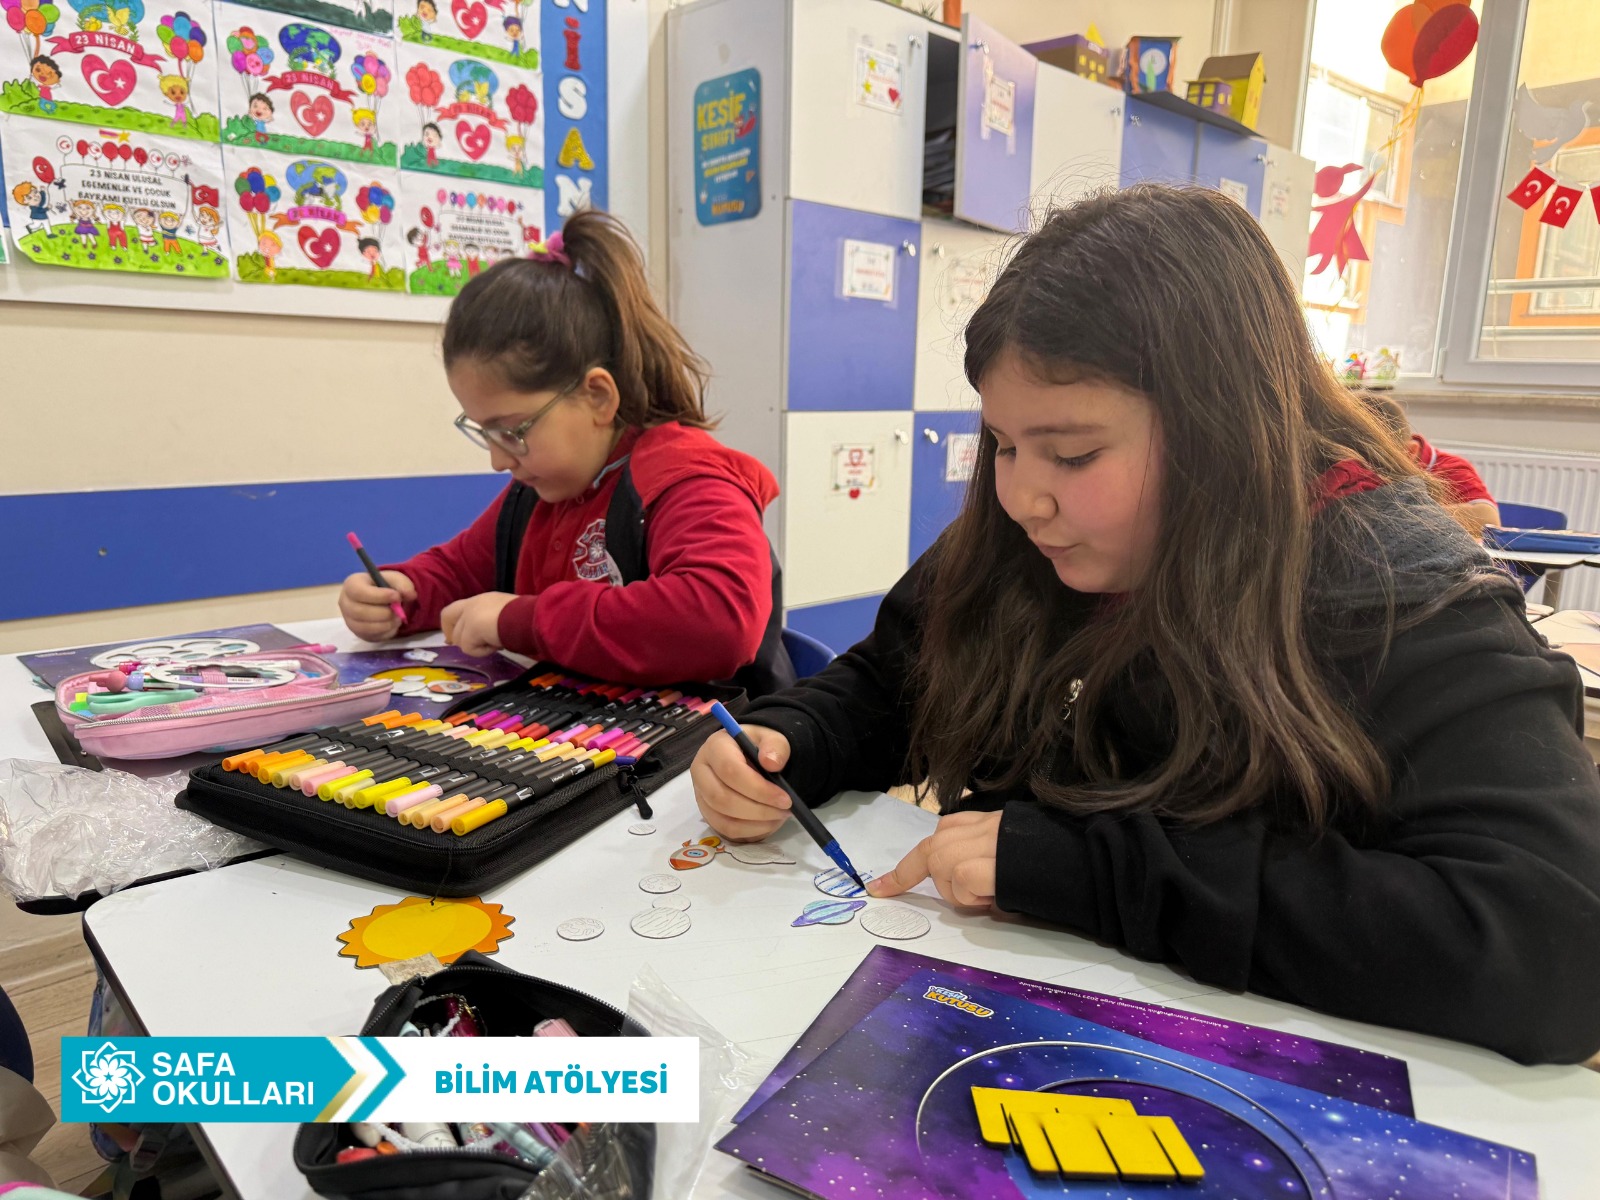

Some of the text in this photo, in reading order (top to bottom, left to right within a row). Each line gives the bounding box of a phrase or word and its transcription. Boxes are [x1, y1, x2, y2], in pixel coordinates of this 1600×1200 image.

[75, 34, 135, 54] 23 NİSAN
[554, 0, 595, 217] İSAN
[90, 169, 102, 178] 23
[132, 175, 163, 185] ULUSAL
[132, 186, 143, 194] VE
[78, 191, 176, 209] BAYRAMI KUTLU OLSUN
[926, 991, 991, 1016] KUTUSU
